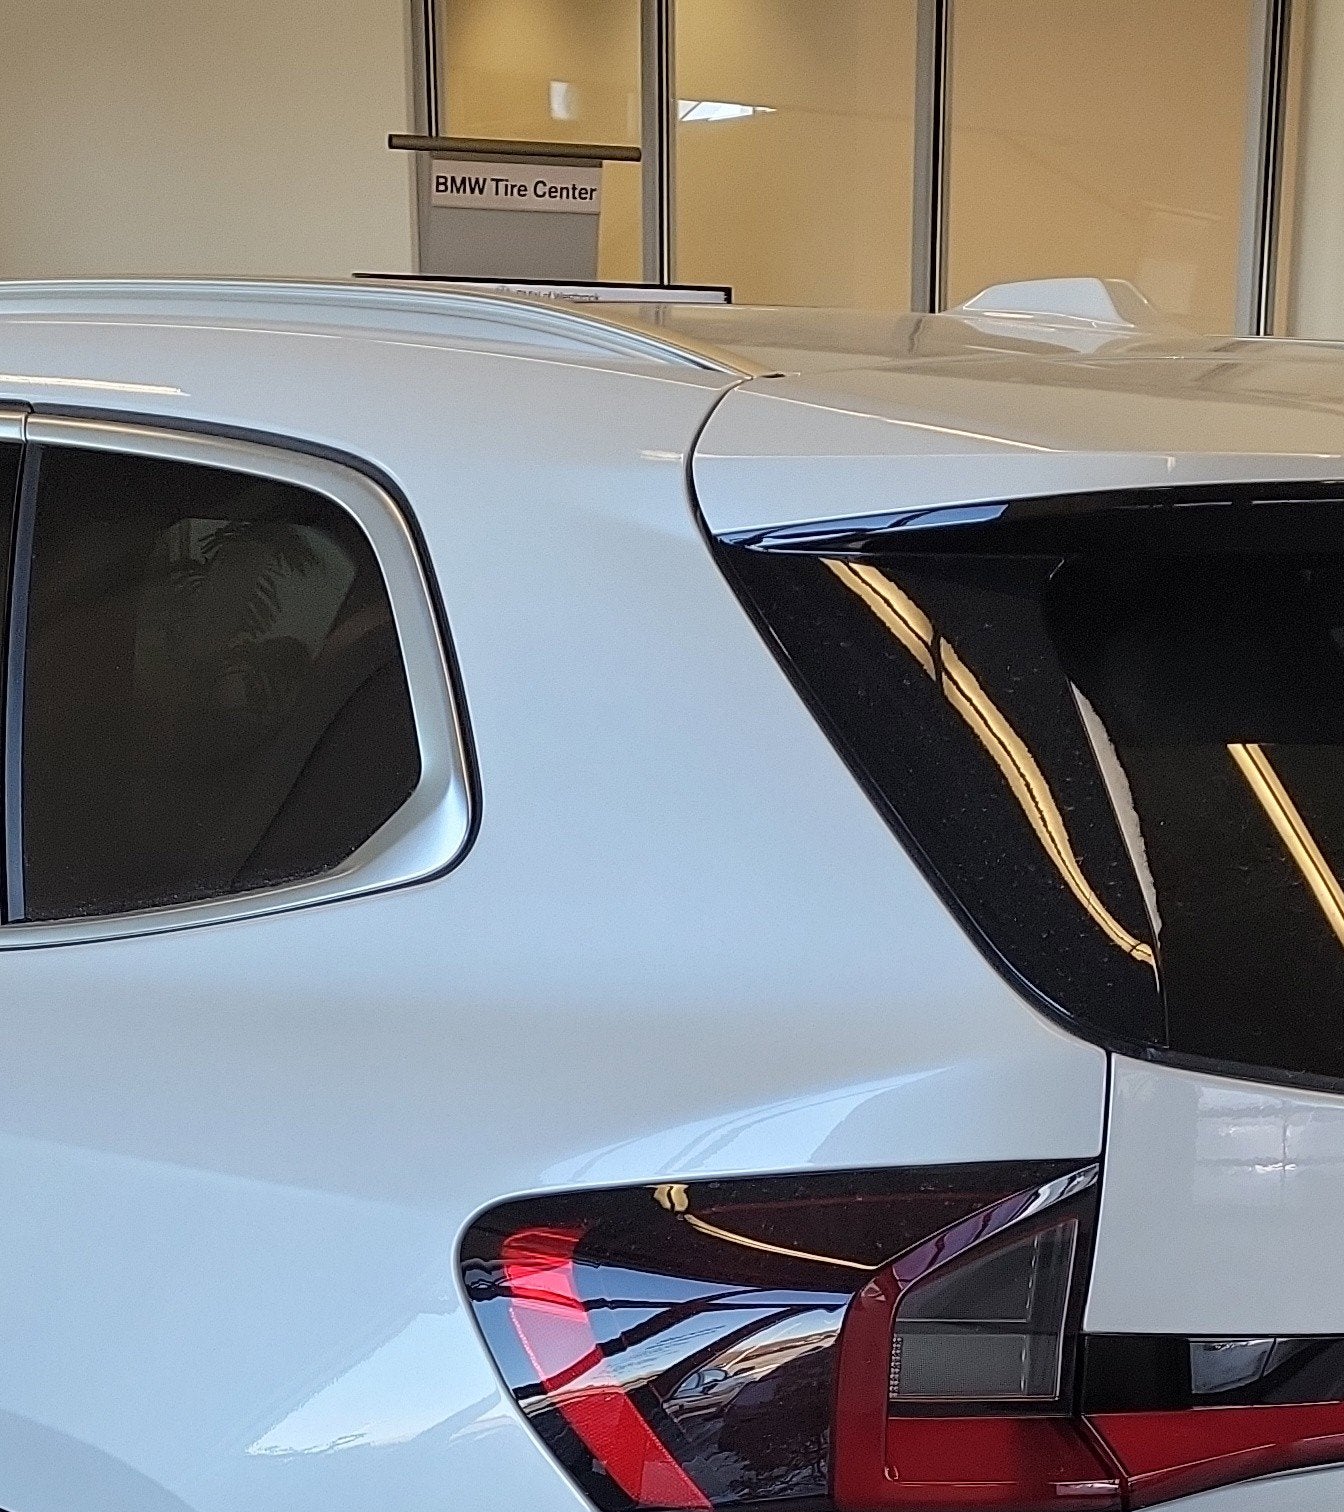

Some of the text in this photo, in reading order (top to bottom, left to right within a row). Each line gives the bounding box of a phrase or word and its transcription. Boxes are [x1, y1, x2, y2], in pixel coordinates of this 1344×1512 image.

[435, 175, 597, 201] BMW Tire Center
